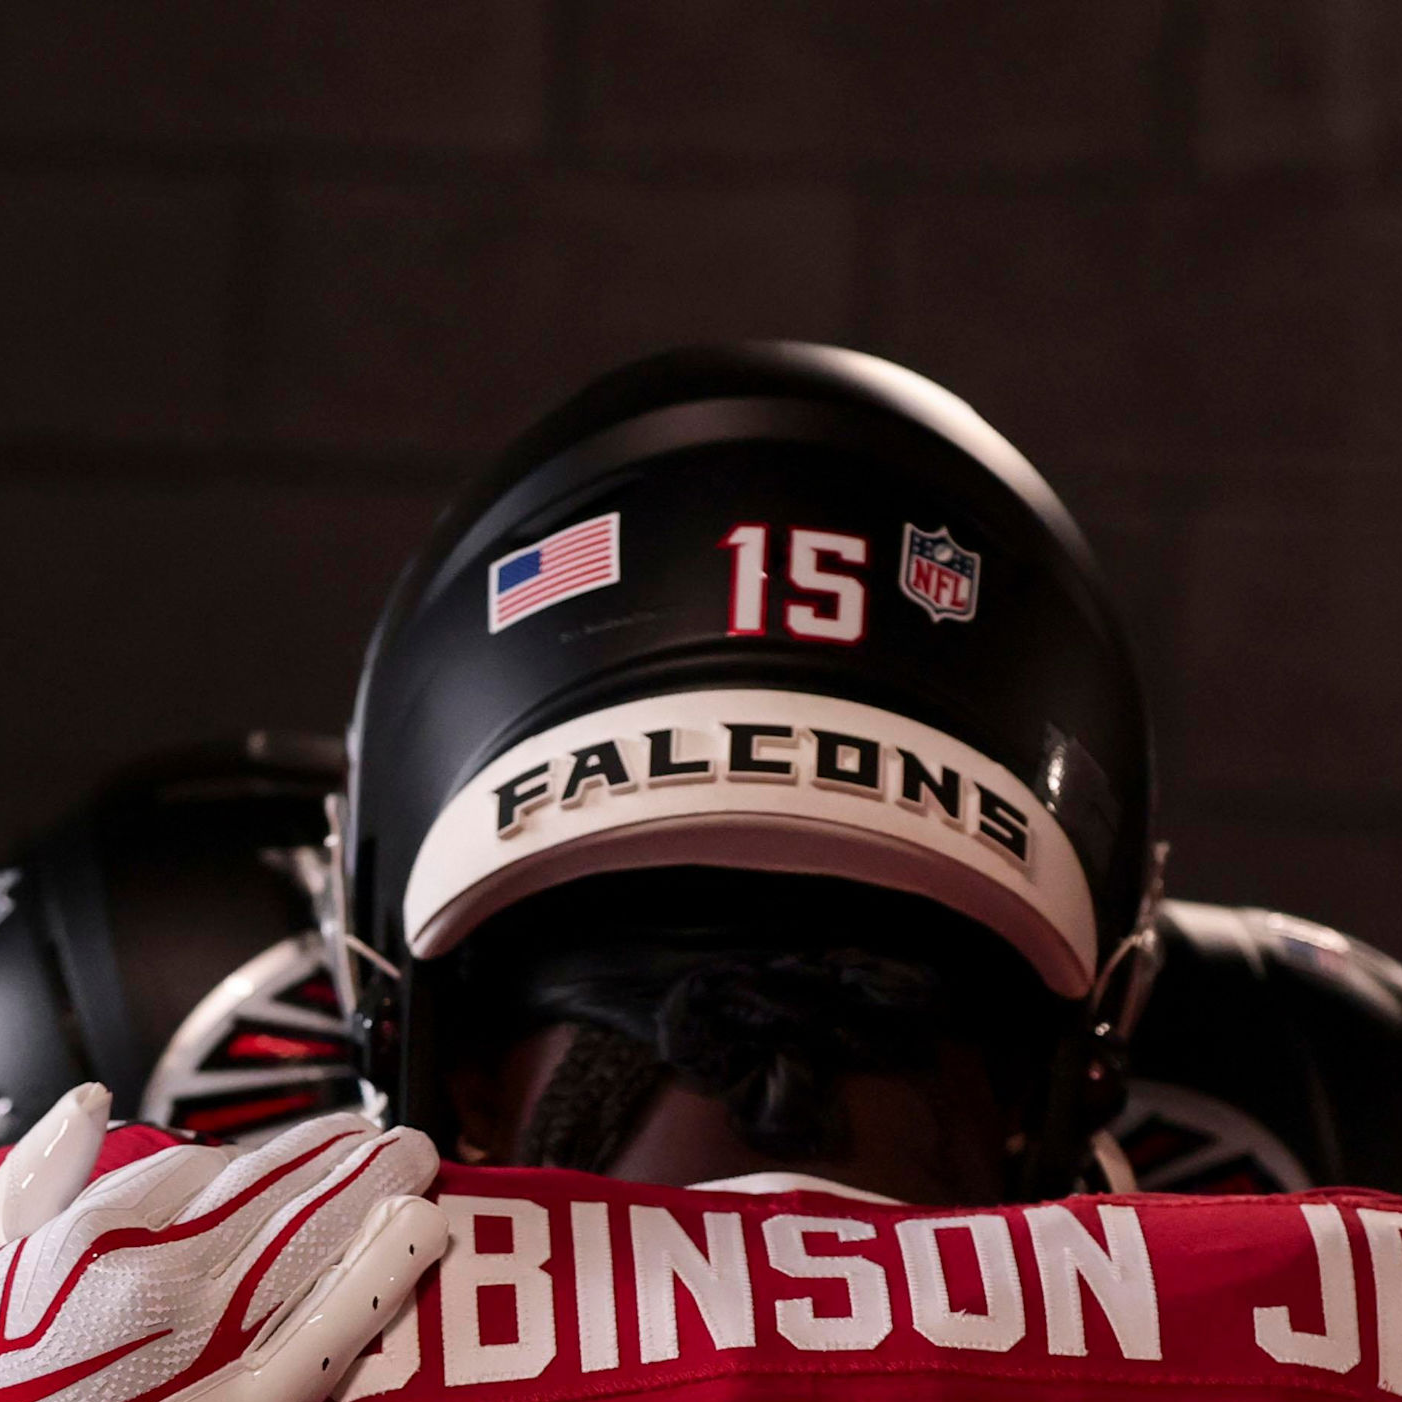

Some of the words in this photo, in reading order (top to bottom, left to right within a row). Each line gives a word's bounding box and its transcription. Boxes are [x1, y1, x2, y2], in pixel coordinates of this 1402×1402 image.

[716, 521, 870, 646] 15
[912, 558, 968, 609] NFL
[491, 722, 1030, 867] FALCONS
